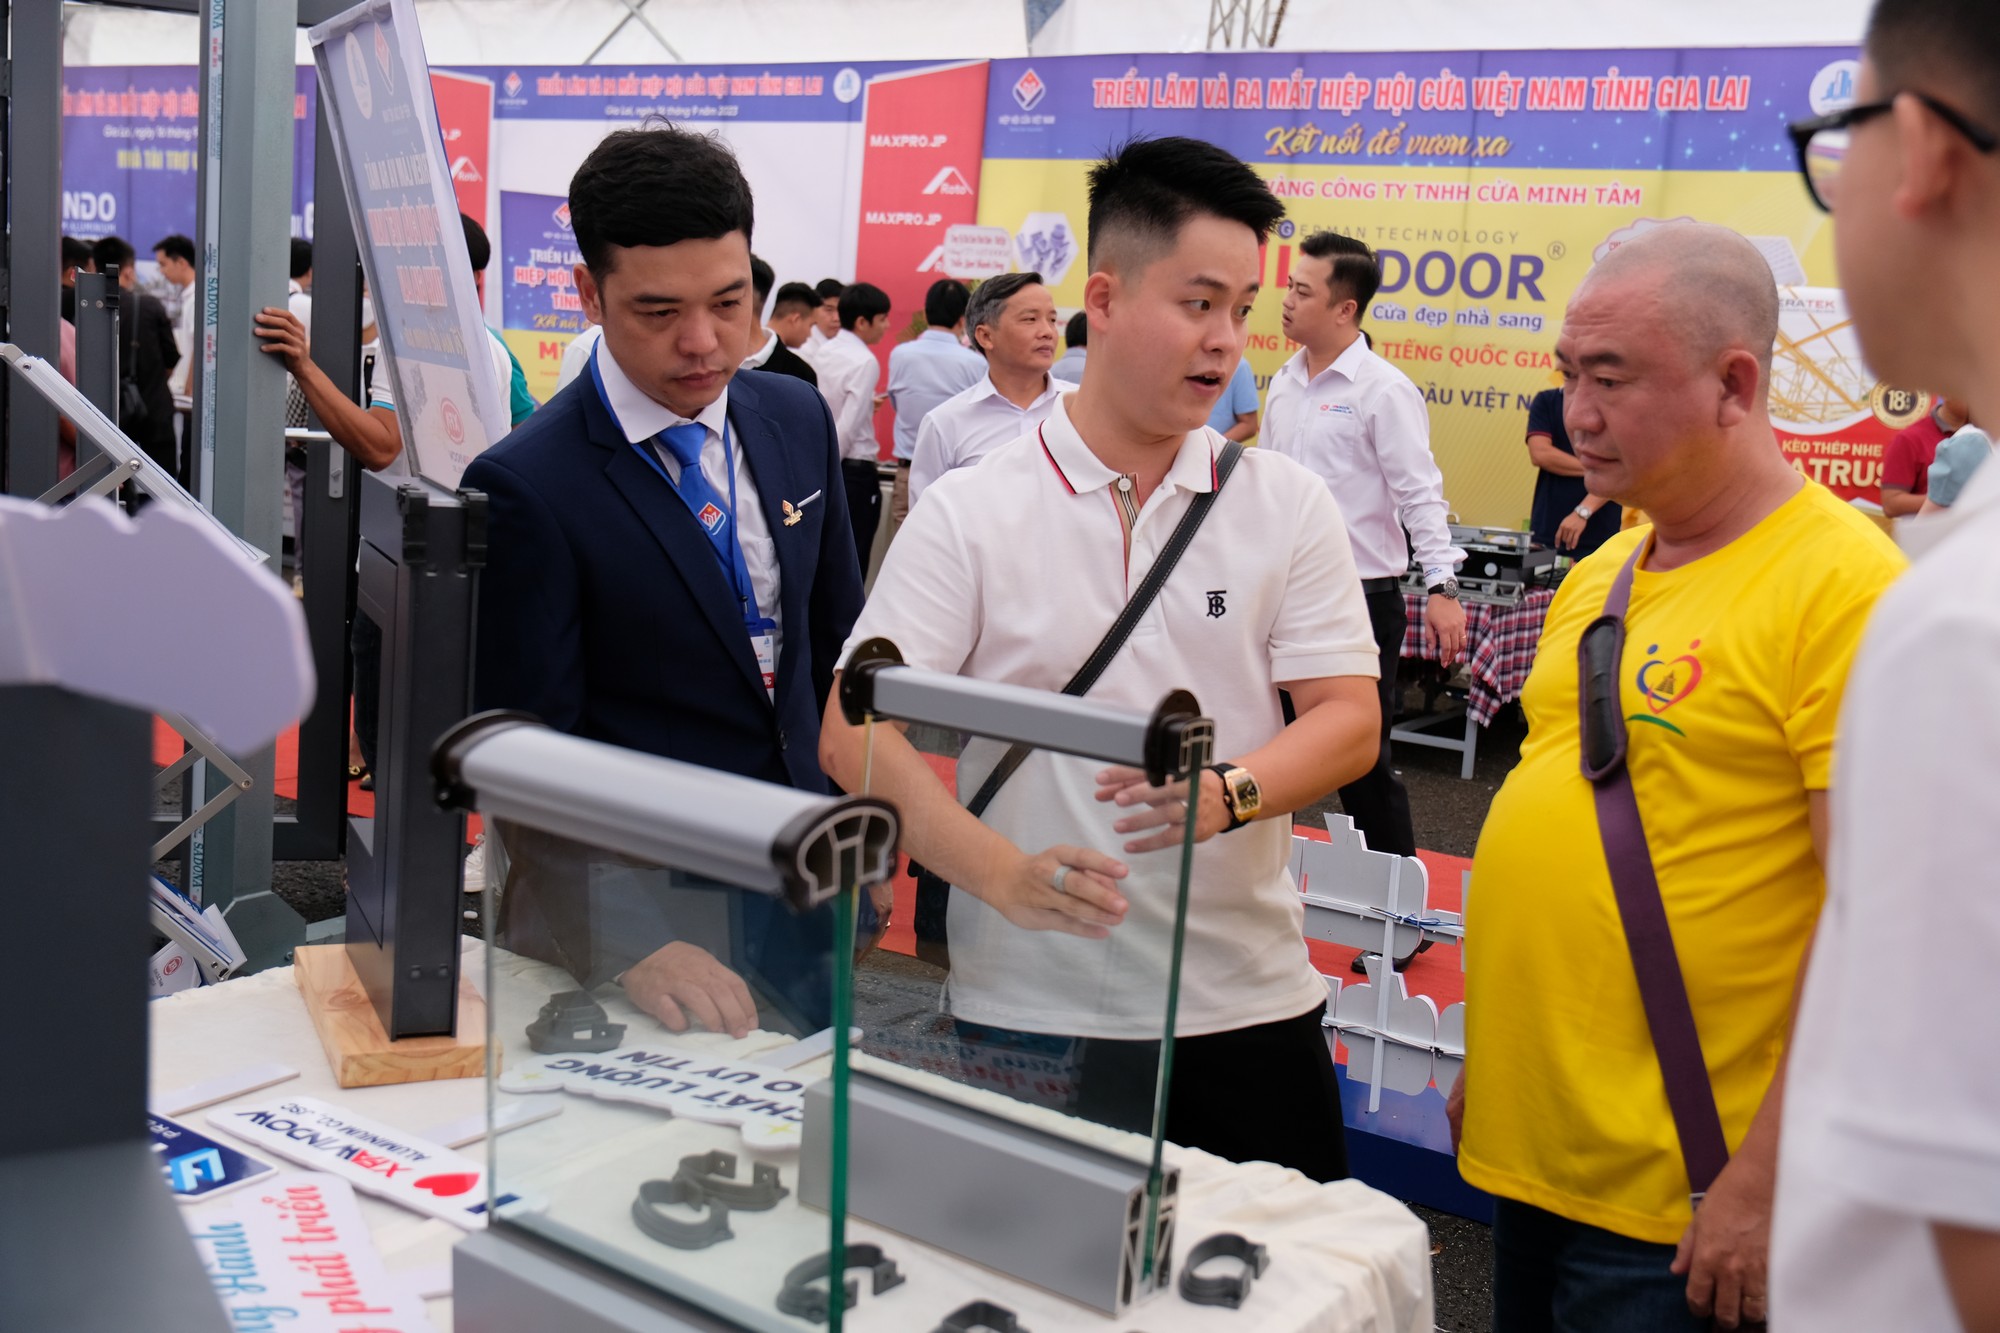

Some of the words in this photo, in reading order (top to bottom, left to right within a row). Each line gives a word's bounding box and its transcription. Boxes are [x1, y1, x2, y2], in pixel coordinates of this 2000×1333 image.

[1093, 67, 1149, 109] TRIỂN
[1153, 72, 1198, 109] LÃM
[1202, 72, 1231, 109] VÀ
[1233, 77, 1262, 109] RA
[1268, 68, 1316, 110] MẮT
[1318, 73, 1371, 116] HIỆP
[1373, 71, 1414, 116] HỘI
[1418, 68, 1466, 110] CỬA
[1471, 71, 1523, 117] VIỆT
[1526, 77, 1588, 111] NAM
[1592, 66, 1652, 111] TỈNH
[1655, 76, 1701, 111] GIA
[1705, 75, 1751, 111] LAI
[870, 134, 947, 148] MAXPRO.JP
[1265, 122, 1322, 156] Kết
[1319, 122, 1363, 155] nối
[1367, 122, 1408, 157] để
[1406, 132, 1472, 157] vươn
[1472, 135, 1511, 158] xa
[458, 170, 478, 182] Roto
[940, 182, 968, 195] Roto
[1321, 177, 1377, 200] CÔNG
[1384, 183, 1406, 200] TY
[1413, 184, 1470, 201] TNHH
[1476, 179, 1520, 203] CỬA
[1526, 186, 1588, 205] MINH
[1595, 181, 1642, 206] TÂM
[865, 211, 943, 226] MAXPRO.JP
[1375, 227, 1519, 244] TECHNOLOGY
[530, 246, 562, 265] TRIỂN
[514, 265, 545, 289] HIỆP
[546, 267, 571, 288] HỘI
[207, 277, 218, 326] SADONA
[1371, 304, 1407, 323] Cửa
[1415, 307, 1448, 328] đẹp
[1456, 306, 1490, 327] nhà
[1497, 313, 1544, 332] sang
[1381, 336, 1443, 363] TIẾNG
[1450, 335, 1508, 367] QUỐC
[1514, 351, 1553, 369] GIA
[1461, 388, 1506, 414] VIỆT
[1887, 390, 1905, 411] 18
[1813, 440, 1850, 455] THÉP
[193, 842, 203, 887] SADONA
[616, 1051, 693, 1071] TÍN
[544, 1058, 700, 1095] LƯỢNG
[696, 1066, 760, 1084] UY
[235, 1110, 413, 1178] XFAWINDOW
[337, 1121, 430, 1161] ALUMINIUM
[261, 1185, 338, 1243] triển
[288, 1252, 393, 1315] phát
